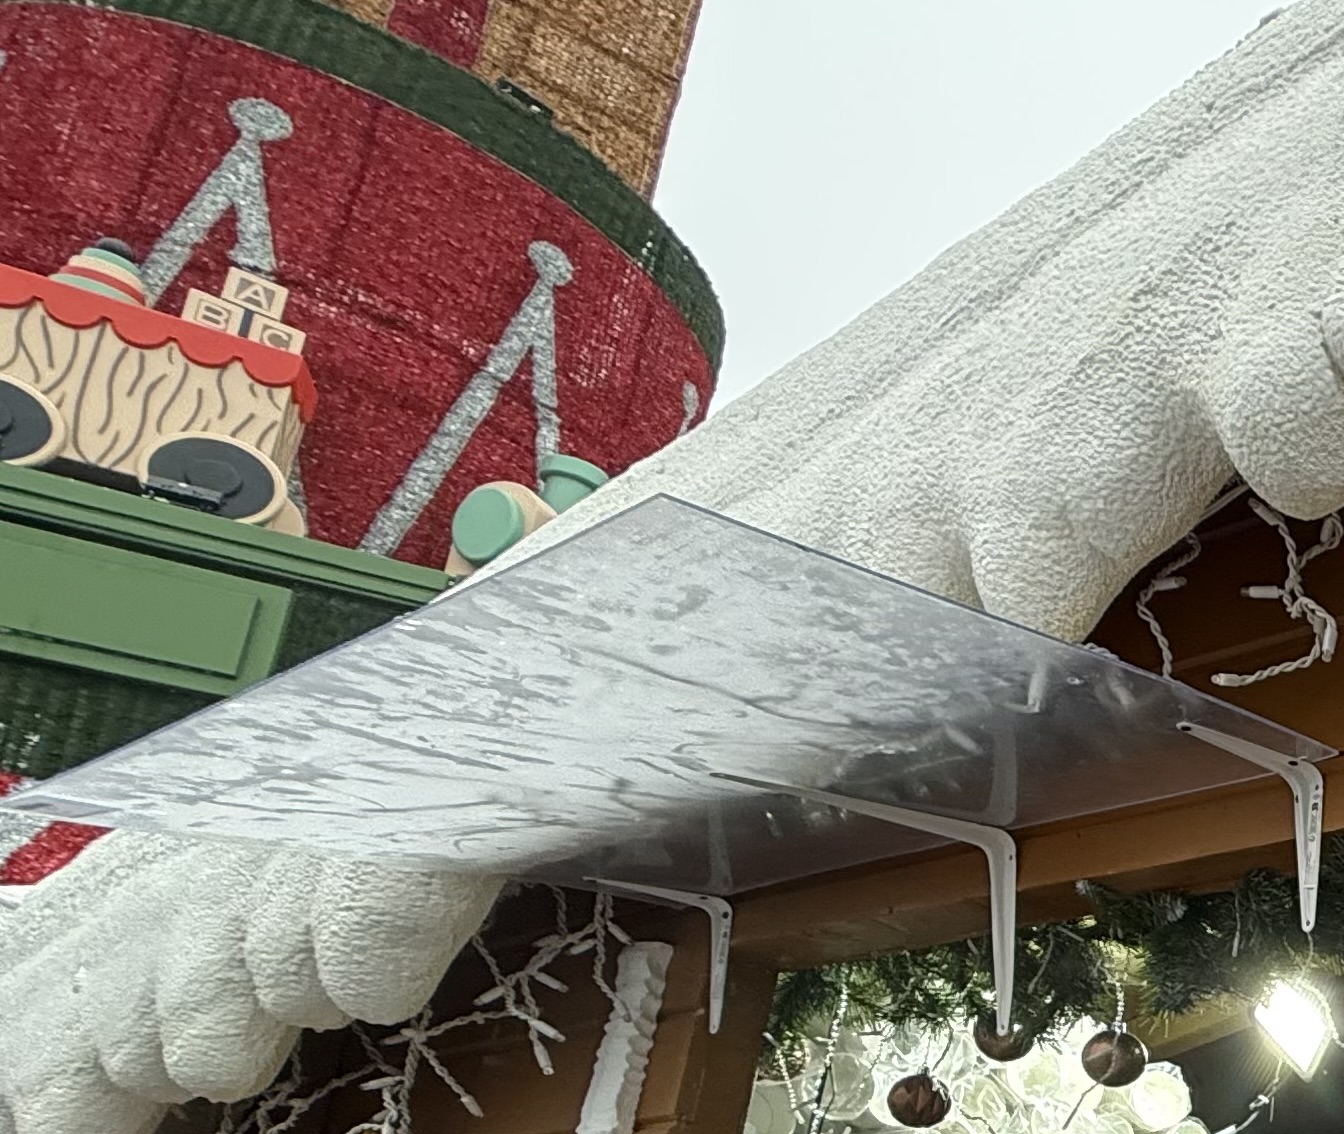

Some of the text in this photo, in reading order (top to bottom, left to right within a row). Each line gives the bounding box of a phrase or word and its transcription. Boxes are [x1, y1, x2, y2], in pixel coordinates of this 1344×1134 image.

[237, 284, 270, 311] A
[197, 305, 229, 331] B
[263, 329, 289, 350] C
